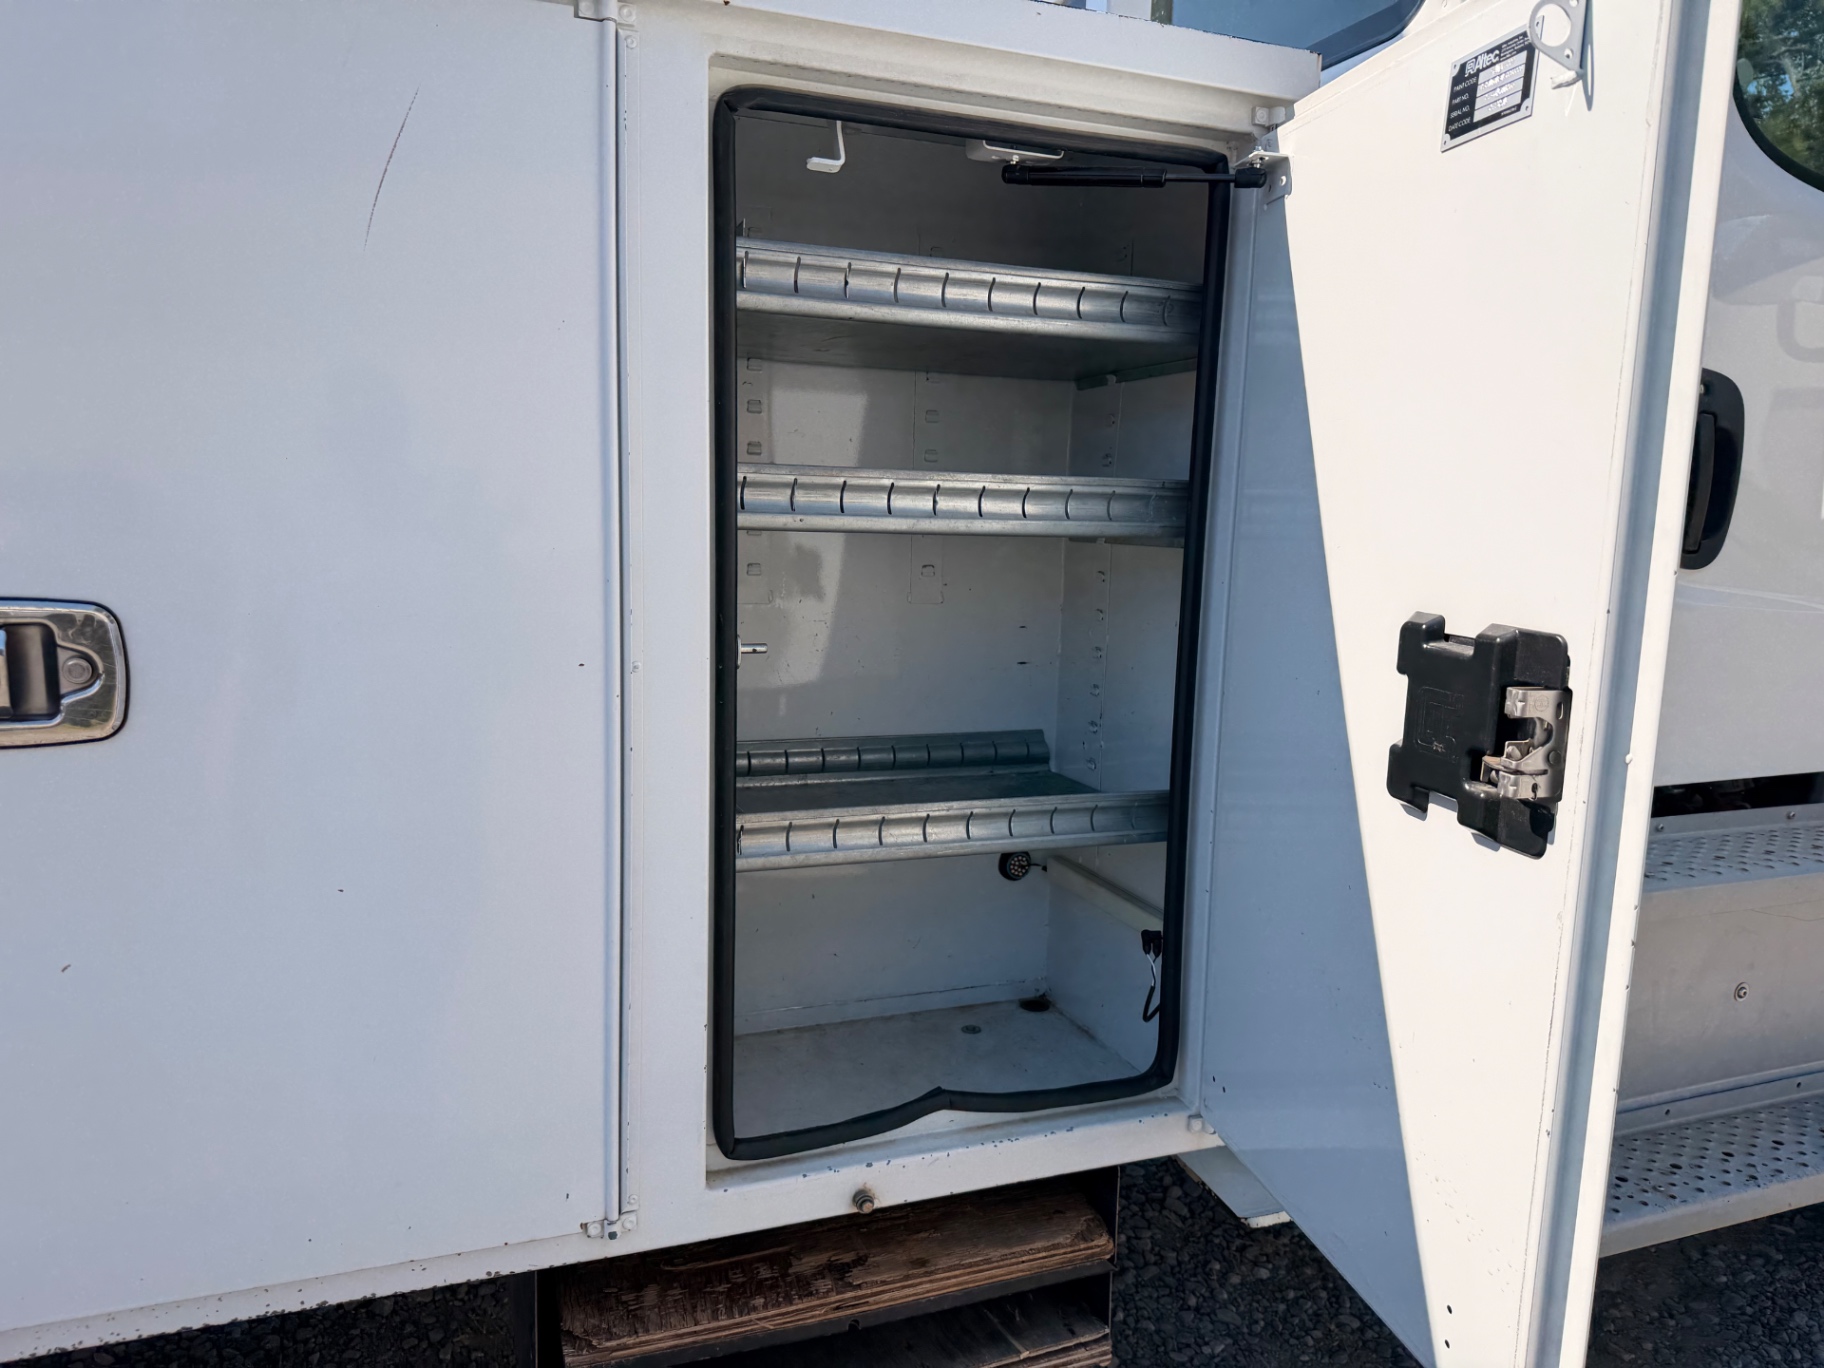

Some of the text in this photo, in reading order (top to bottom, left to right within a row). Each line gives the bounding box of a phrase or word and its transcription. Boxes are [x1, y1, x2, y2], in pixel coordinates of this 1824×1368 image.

[1474, 49, 1500, 73] Altec
[1453, 82, 1465, 92] PAINT
[1465, 76, 1477, 88] CODE
[1458, 117, 1471, 127] CODE
